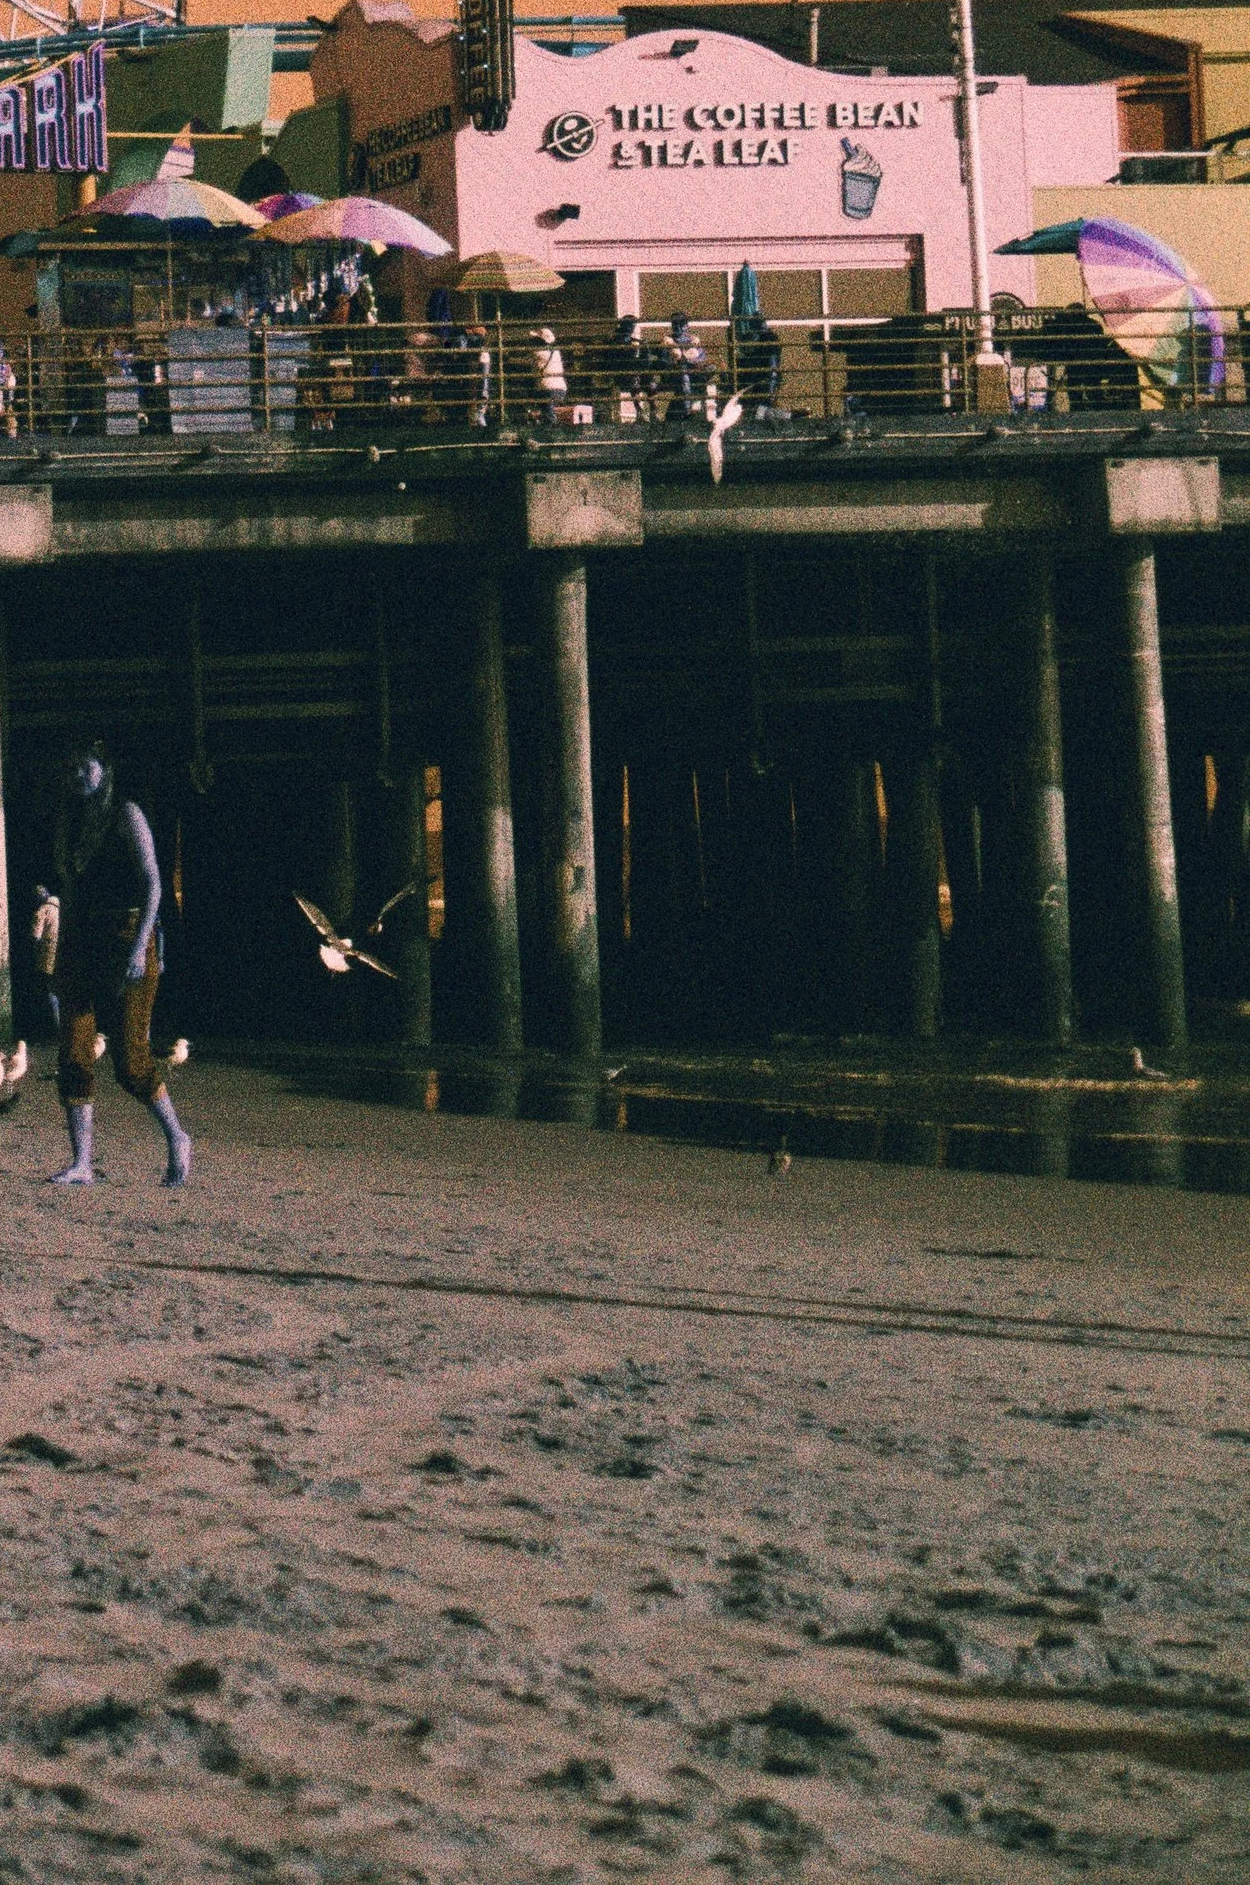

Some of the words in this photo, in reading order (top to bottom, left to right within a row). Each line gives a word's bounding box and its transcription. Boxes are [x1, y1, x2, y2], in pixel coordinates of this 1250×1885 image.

[612, 102, 678, 131] THE
[691, 102, 818, 130] COFFEE
[833, 101, 924, 128] BEAN
[646, 140, 712, 166] TEA
[720, 138, 800, 165] LEAF
